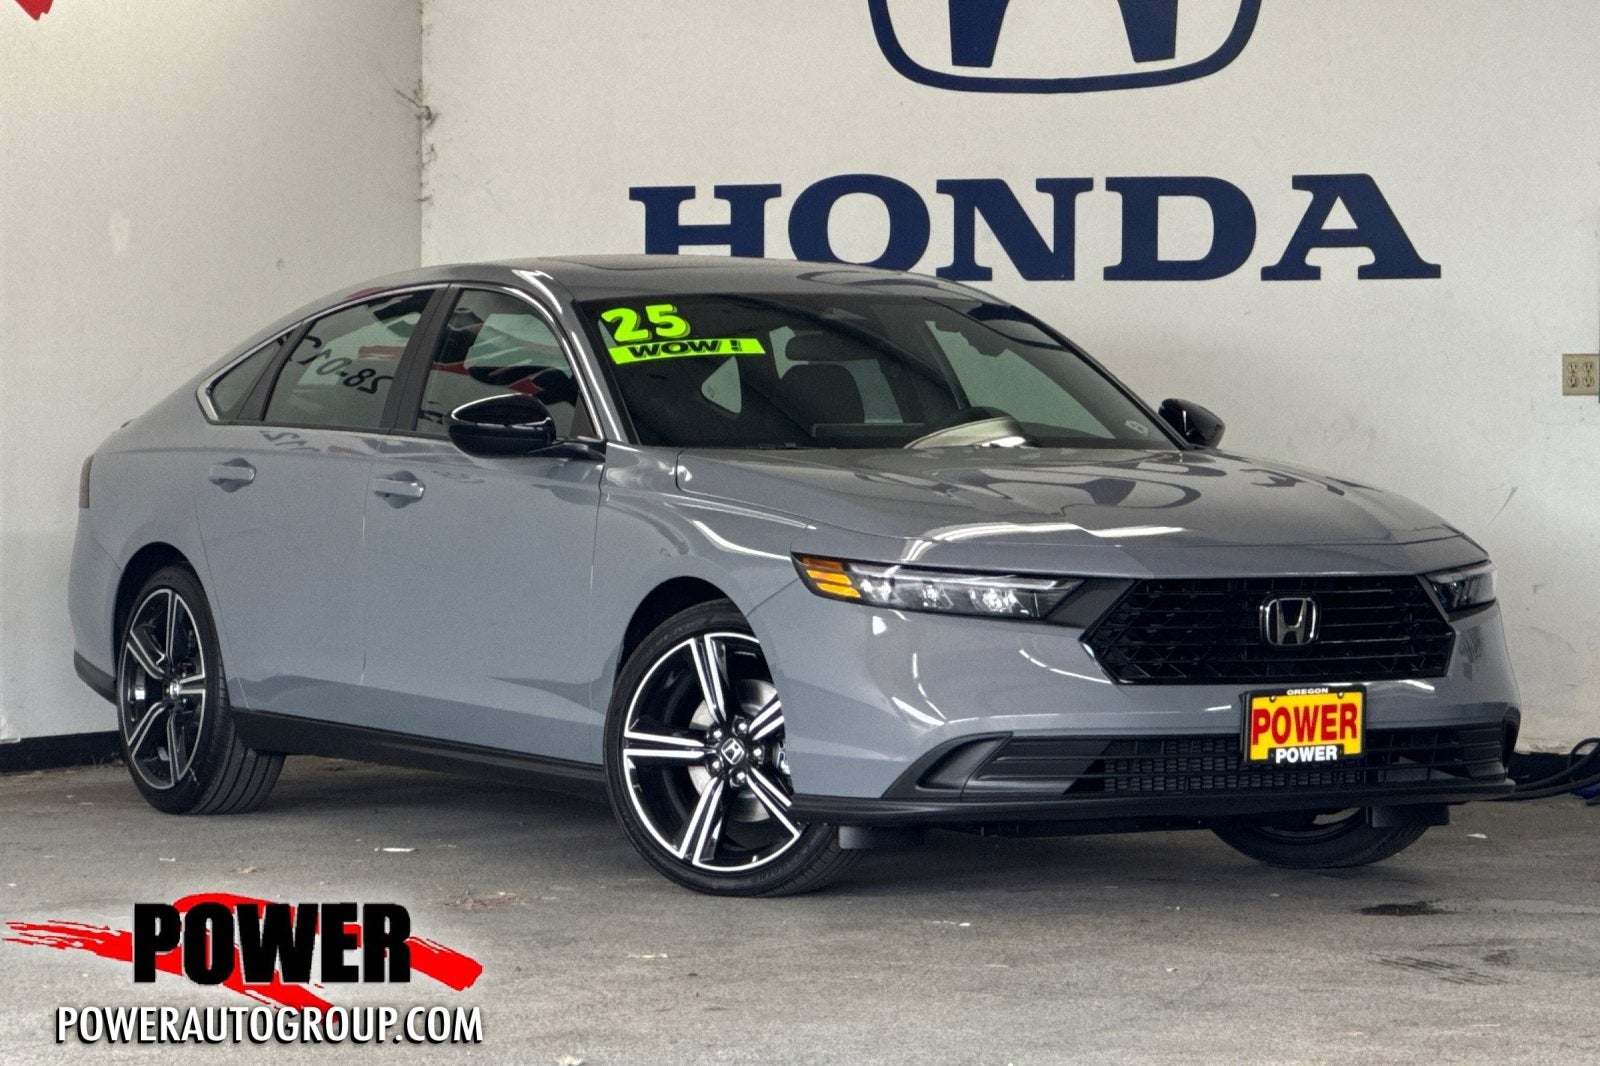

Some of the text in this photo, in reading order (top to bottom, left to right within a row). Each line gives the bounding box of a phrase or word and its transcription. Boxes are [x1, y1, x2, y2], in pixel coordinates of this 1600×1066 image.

[629, 173, 1441, 281] HONDA
[601, 304, 689, 342] 25
[1286, 687, 1329, 696] OREGON
[1252, 703, 1358, 745] POWER
[1275, 745, 1338, 764] POWER
